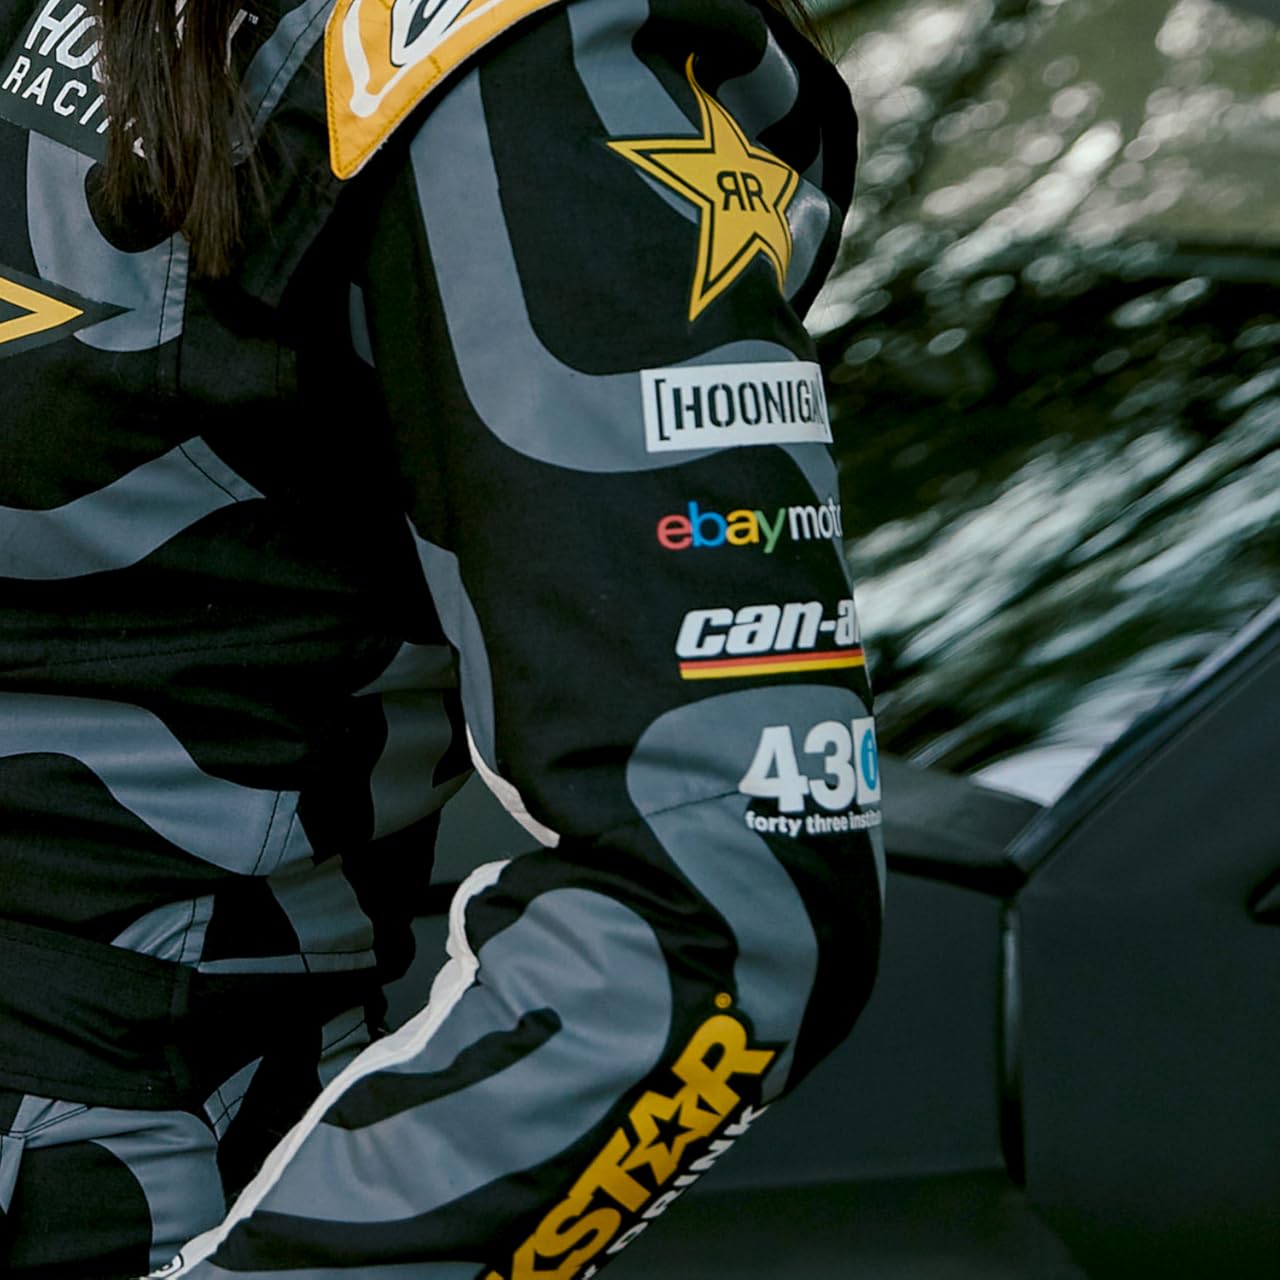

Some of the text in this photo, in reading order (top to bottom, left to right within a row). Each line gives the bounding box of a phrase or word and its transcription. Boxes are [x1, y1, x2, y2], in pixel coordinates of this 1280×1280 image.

[2, 55, 135, 140] RACI
[675, 599, 860, 658] can-a
[745, 810, 802, 837] forty
[806, 814, 848, 834] three
